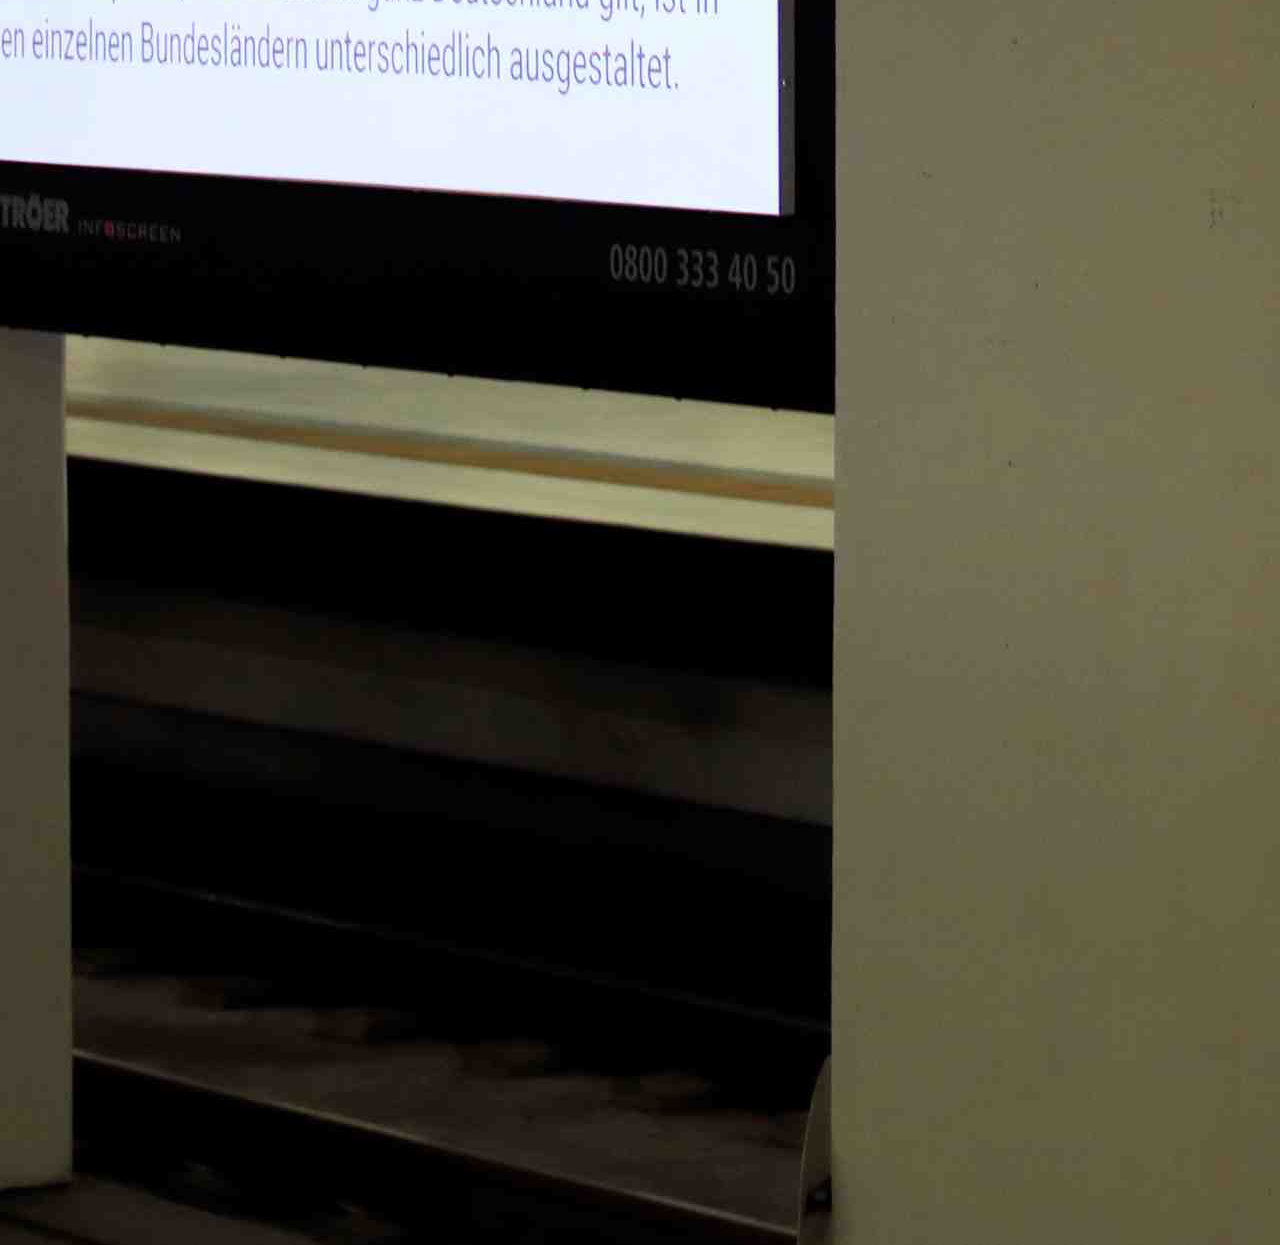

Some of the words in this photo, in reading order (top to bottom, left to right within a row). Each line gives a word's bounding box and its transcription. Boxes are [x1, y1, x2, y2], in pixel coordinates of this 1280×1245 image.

[32, 18, 132, 62] einzelnen
[141, 21, 307, 68] Bundesländern
[316, 29, 500, 79] unterschiedlich
[510, 39, 678, 95] ausgestaltet.
[610, 243, 668, 284] 0800
[677, 248, 719, 288] 333
[727, 254, 757, 291] 40
[767, 256, 795, 294] 50
